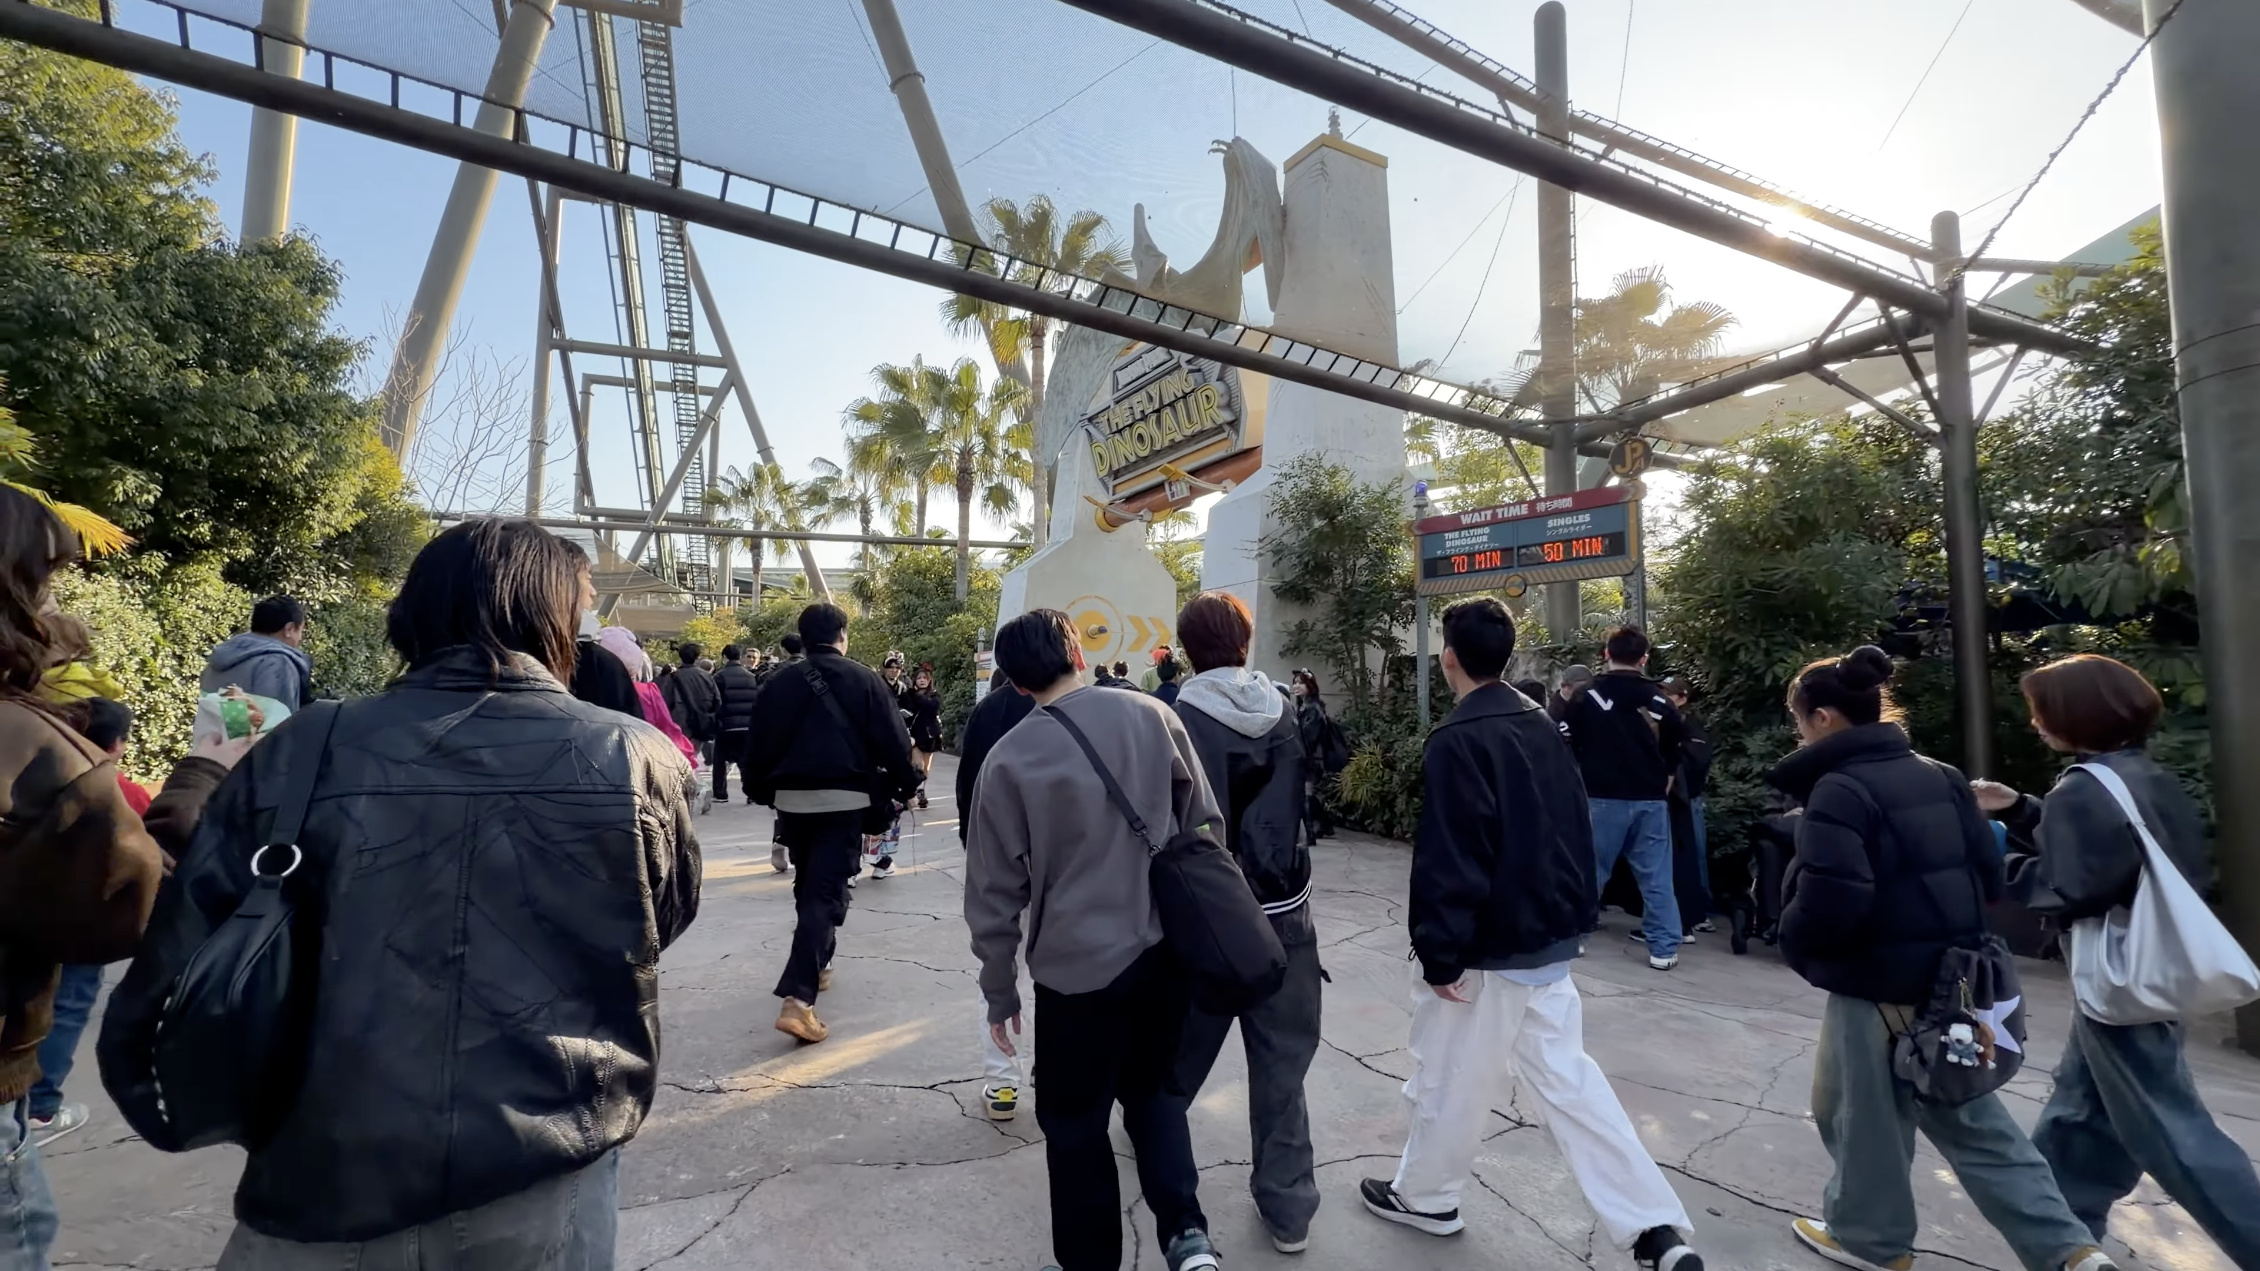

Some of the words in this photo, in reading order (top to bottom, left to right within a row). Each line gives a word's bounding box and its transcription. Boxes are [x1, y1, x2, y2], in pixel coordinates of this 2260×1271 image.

[1099, 401, 1134, 435] THE
[1131, 368, 1195, 420] FLYING
[1091, 383, 1225, 478] DINOSAUR
[1460, 509, 1492, 525] WAIT
[1496, 503, 1529, 519] TIME
[1536, 497, 1573, 513] 待ち時間
[1547, 513, 1591, 528] SINGLES
[1444, 532, 1460, 541] THE
[1461, 526, 1491, 538] FLYING
[1445, 535, 1489, 548] DINOSAUR
[1543, 542, 1564, 563] 50
[1571, 536, 1603, 558] MIN
[1451, 555, 1468, 574] 70
[1475, 550, 1501, 570] MIN
